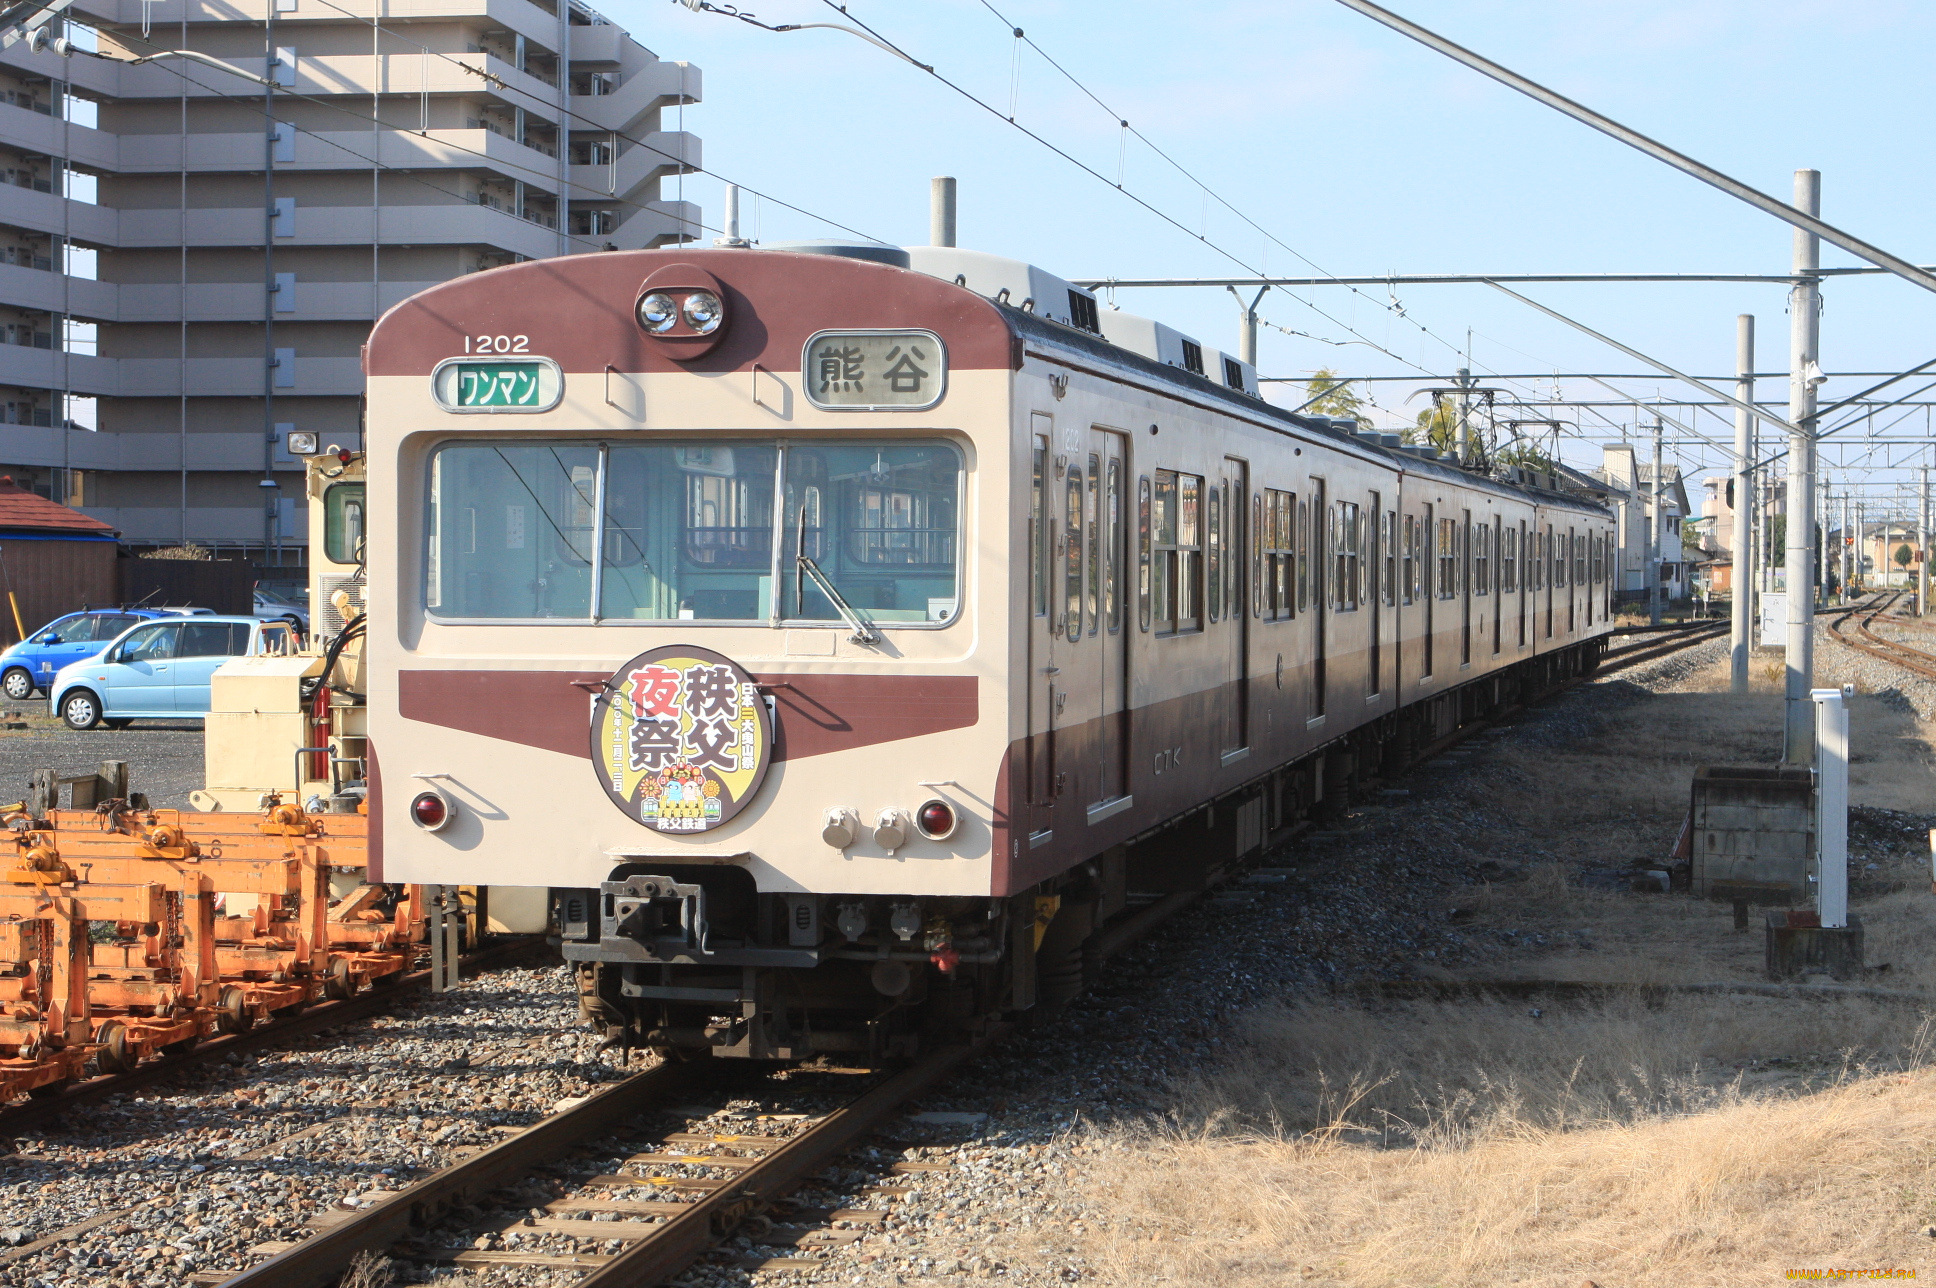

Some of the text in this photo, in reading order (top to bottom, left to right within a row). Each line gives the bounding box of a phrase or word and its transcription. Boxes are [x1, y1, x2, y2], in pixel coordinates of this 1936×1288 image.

[465, 335, 529, 353] 1202
[818, 345, 929, 393] 熊谷
[460, 370, 536, 405] ワンマン
[630, 667, 680, 769] 夜祭
[686, 666, 737, 770] 秩父
[1153, 746, 1181, 776] CTK
[657, 817, 707, 830] 秩父鉄道
